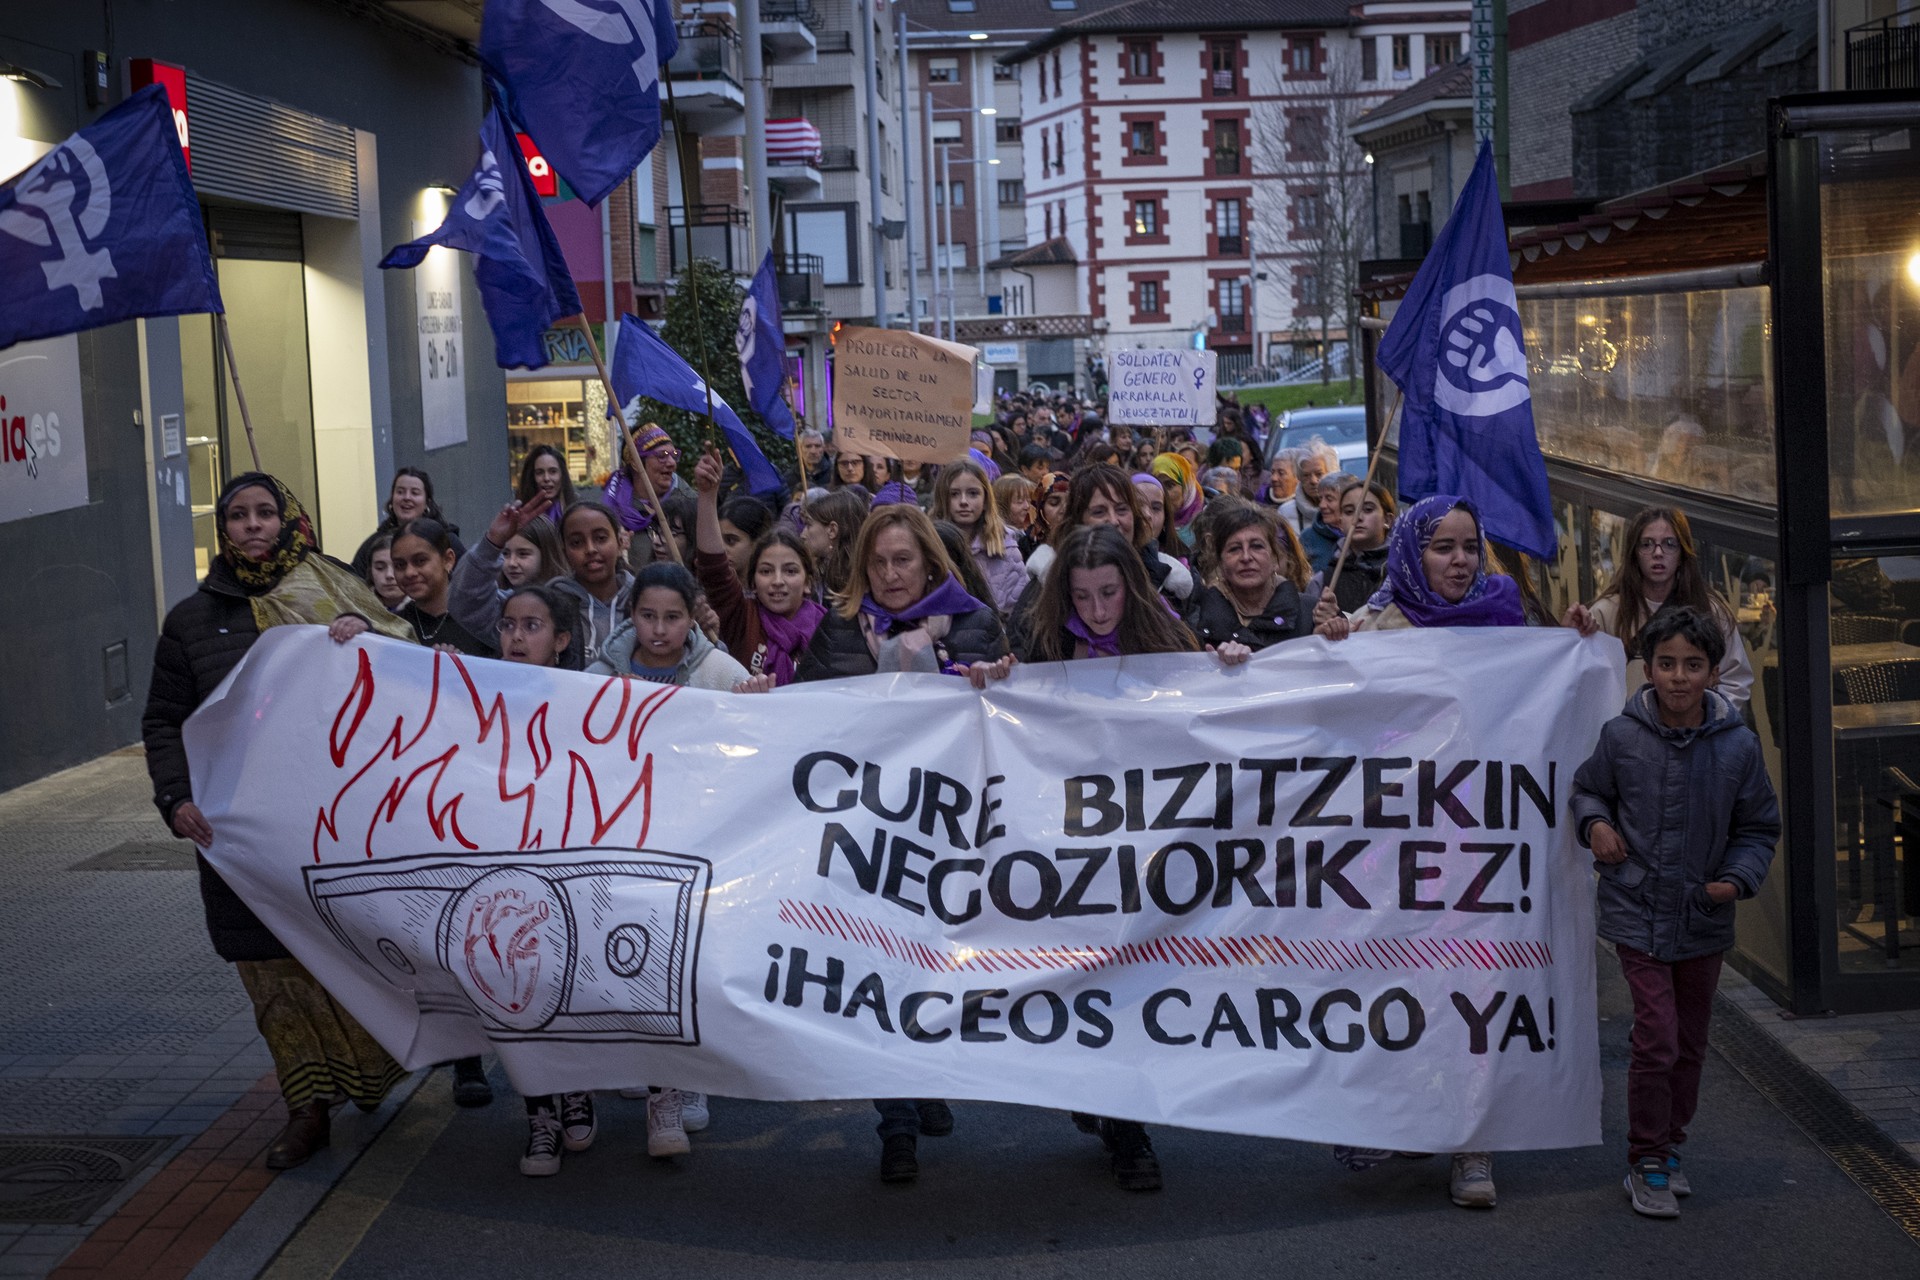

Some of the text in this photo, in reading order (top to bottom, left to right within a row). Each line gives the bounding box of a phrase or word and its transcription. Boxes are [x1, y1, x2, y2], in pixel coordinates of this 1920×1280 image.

[846, 339, 949, 364] PROTEGER LA
[1117, 353, 1183, 367] SOLDATEN
[844, 365, 938, 384] SALUD DE UN
[1123, 371, 1177, 387] GENERO
[872, 386, 923, 402] SECTOR
[1112, 390, 1187, 403] ARRAKALAK
[845, 403, 963, 428] MAYORITARIAMEN
[843, 427, 938, 448] TE FEMINIZADO
[792, 751, 1557, 850] GURE BIZITZEKIN
[817, 822, 1532, 925] NEGOZIORIK EZ!
[764, 943, 1556, 1055] ¡HACEOS CARGO YA!
